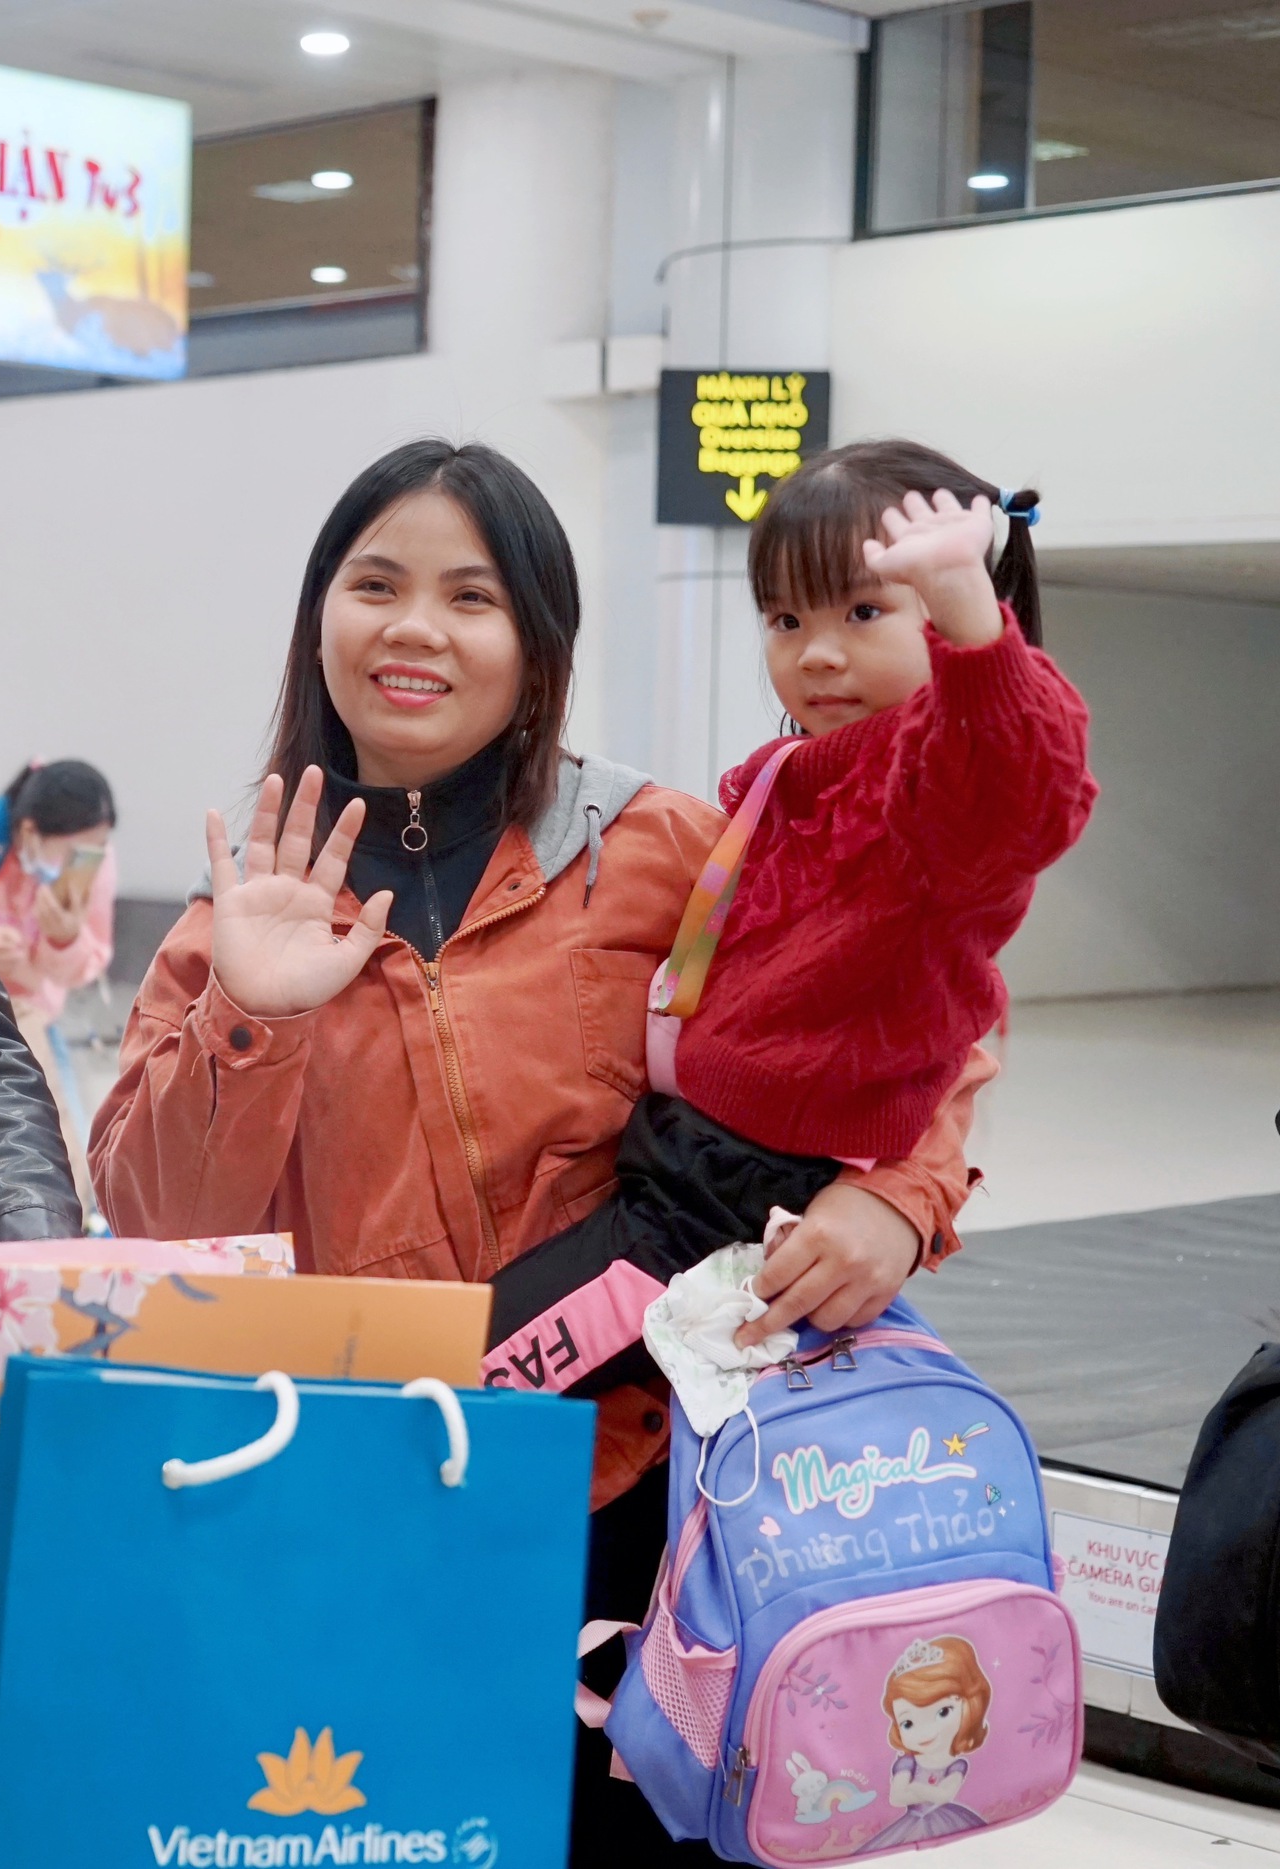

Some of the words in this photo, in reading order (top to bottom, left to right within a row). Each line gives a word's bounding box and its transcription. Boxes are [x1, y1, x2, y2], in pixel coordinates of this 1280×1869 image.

[772, 1427, 977, 1519] Magical
[1087, 1540, 1121, 1562] KHU
[1124, 1548, 1160, 1571] VỰC
[1068, 1560, 1135, 1590] CAMERA
[1087, 1590, 1107, 1605] You
[1108, 1597, 1124, 1609] are
[1125, 1601, 1140, 1612] on
